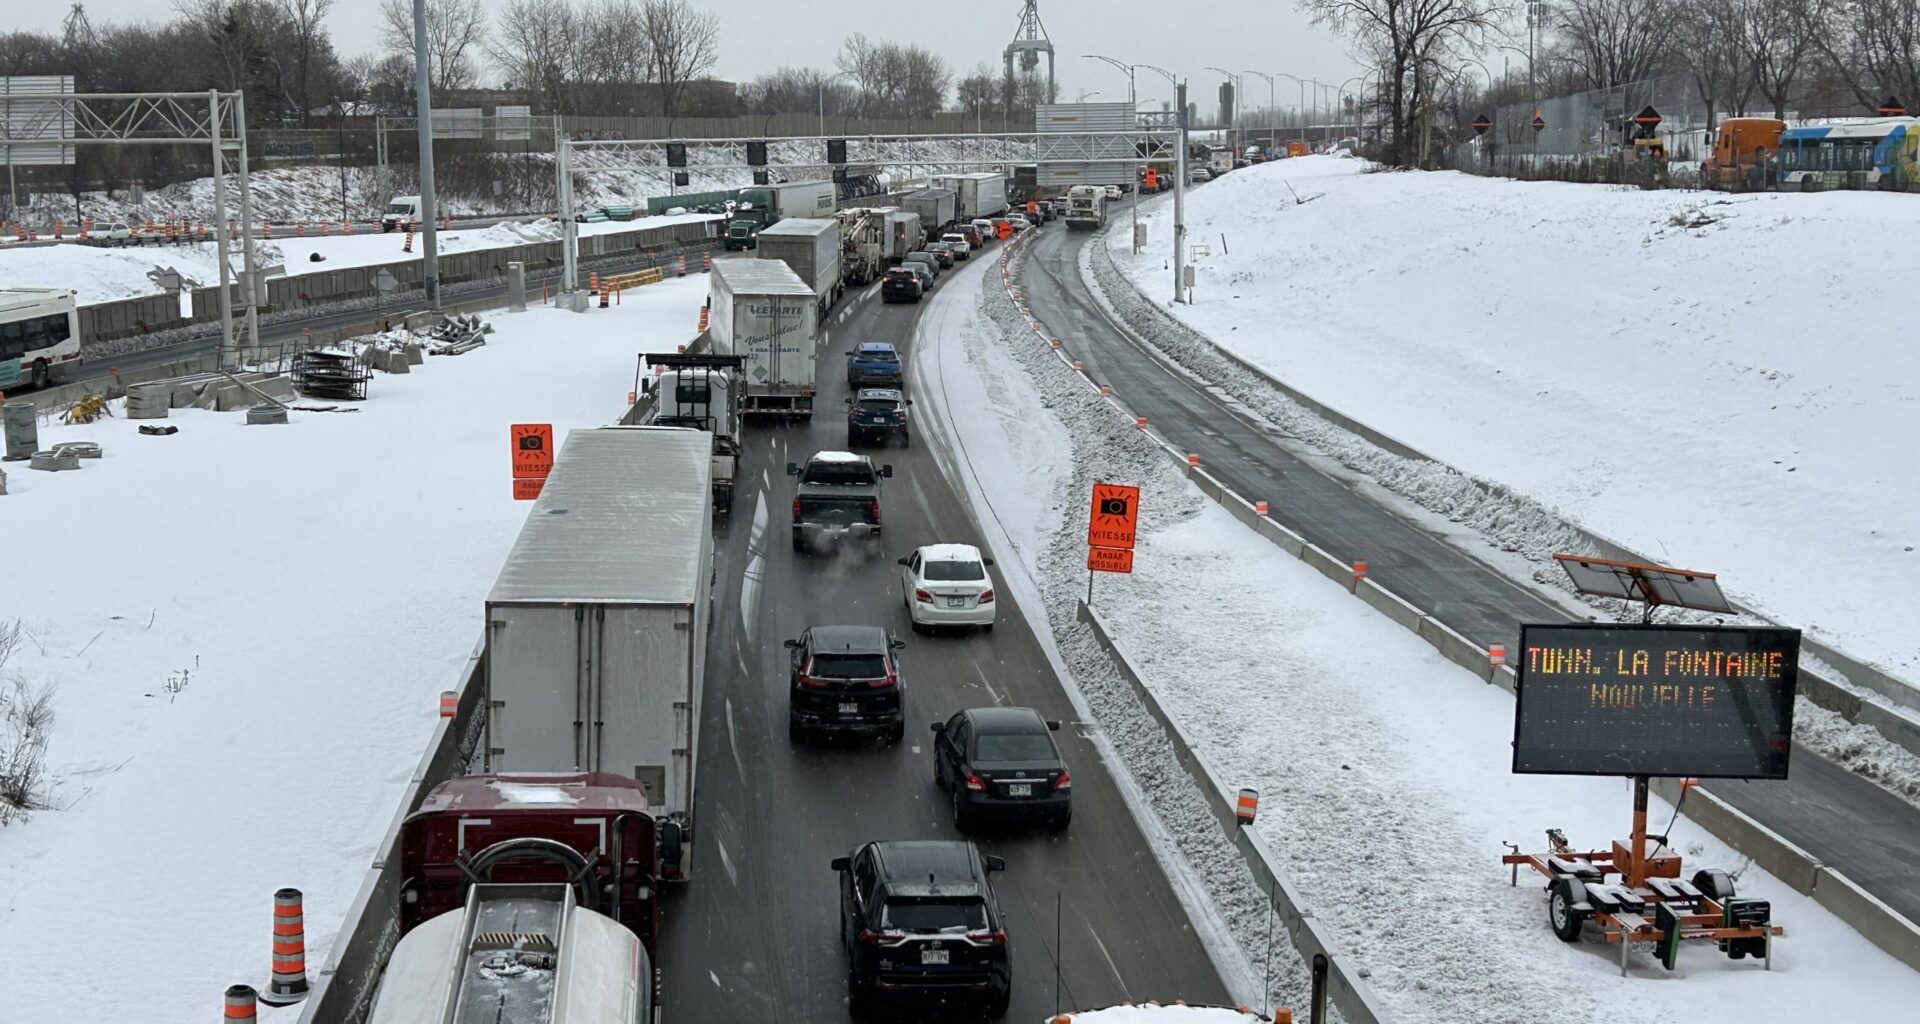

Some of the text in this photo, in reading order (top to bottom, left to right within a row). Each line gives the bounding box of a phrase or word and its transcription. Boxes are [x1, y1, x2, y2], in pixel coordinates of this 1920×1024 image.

[756, 306, 803, 315] LETARTE
[516, 464, 551, 472] VITESSE
[1092, 530, 1133, 542] VITESSE
[1097, 552, 1123, 560] RADAR
[1090, 560, 1128, 570] POSSIBLE
[1528, 648, 1783, 679] TUNN. LA FONTAINE
